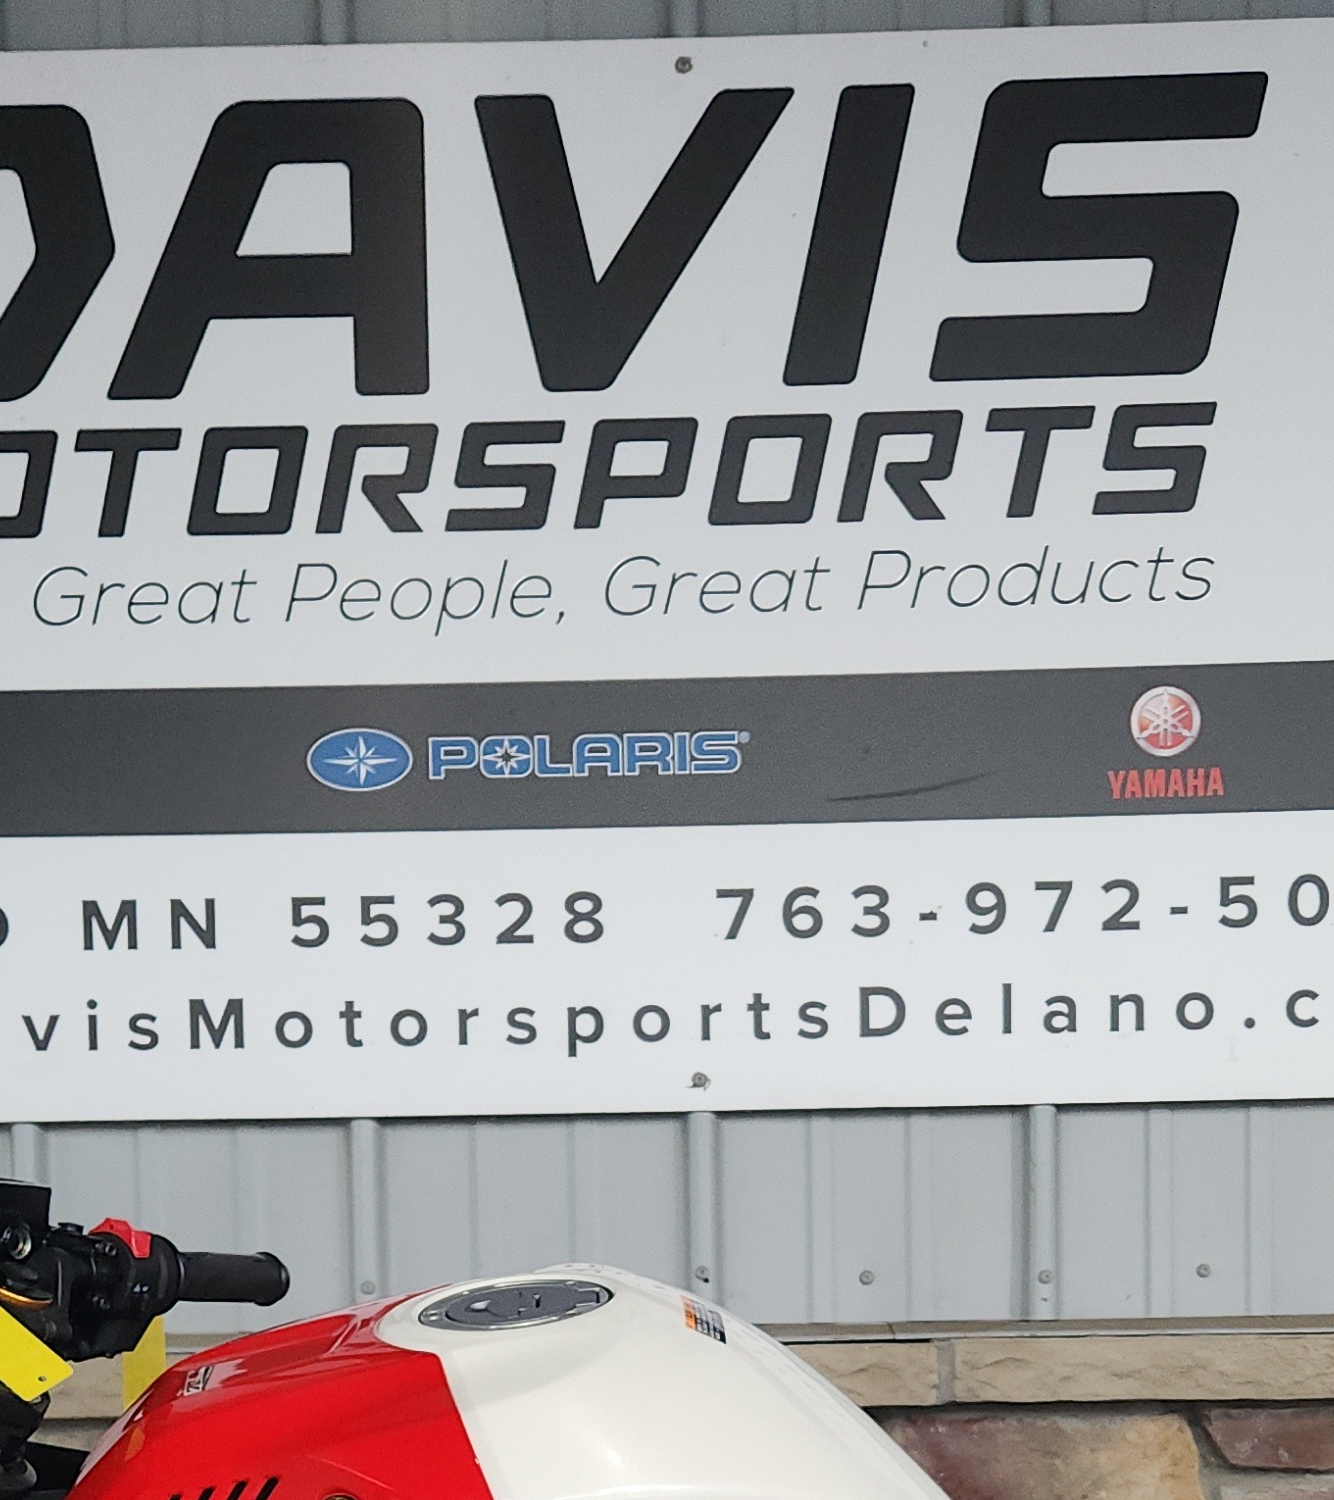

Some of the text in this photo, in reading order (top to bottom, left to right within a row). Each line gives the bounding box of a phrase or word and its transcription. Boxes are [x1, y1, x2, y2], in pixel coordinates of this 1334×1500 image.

[33, 545, 1215, 637] Great People, Great Products
[428, 731, 743, 780] POLARIS
[1107, 766, 1224, 800] YAMAHA
[81, 897, 217, 951] MN
[290, 891, 605, 949] 55328
